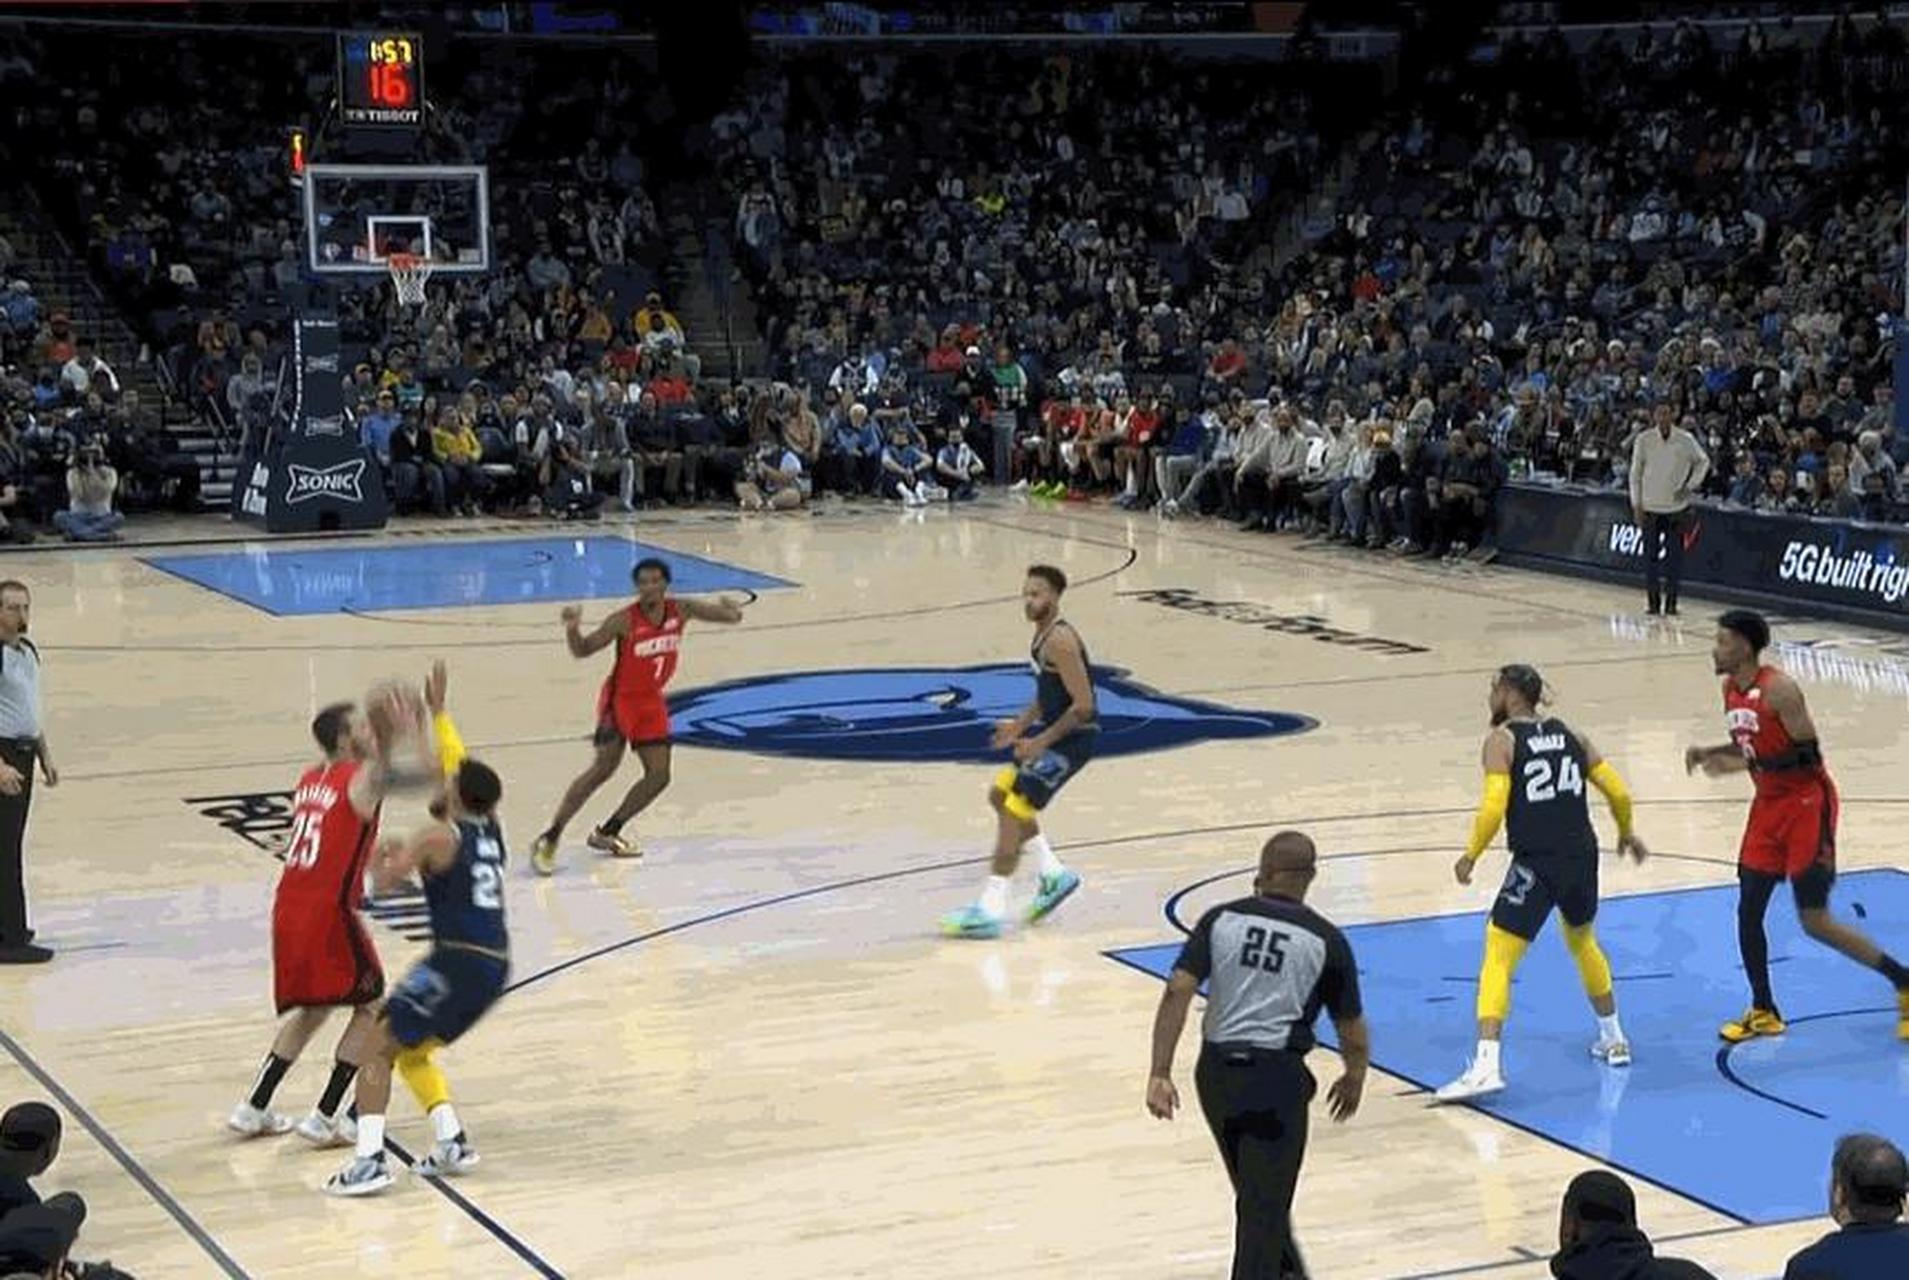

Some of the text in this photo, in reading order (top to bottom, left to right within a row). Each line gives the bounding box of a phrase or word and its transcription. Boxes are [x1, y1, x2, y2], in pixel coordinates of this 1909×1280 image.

[370, 39, 413, 64] 1:57
[370, 65, 408, 105] 16
[297, 474, 354, 491] SONIC
[1779, 541, 1819, 581] 5G
[1815, 546, 1872, 589] built
[1523, 755, 1583, 803] 24
[1240, 925, 1291, 974] 25
